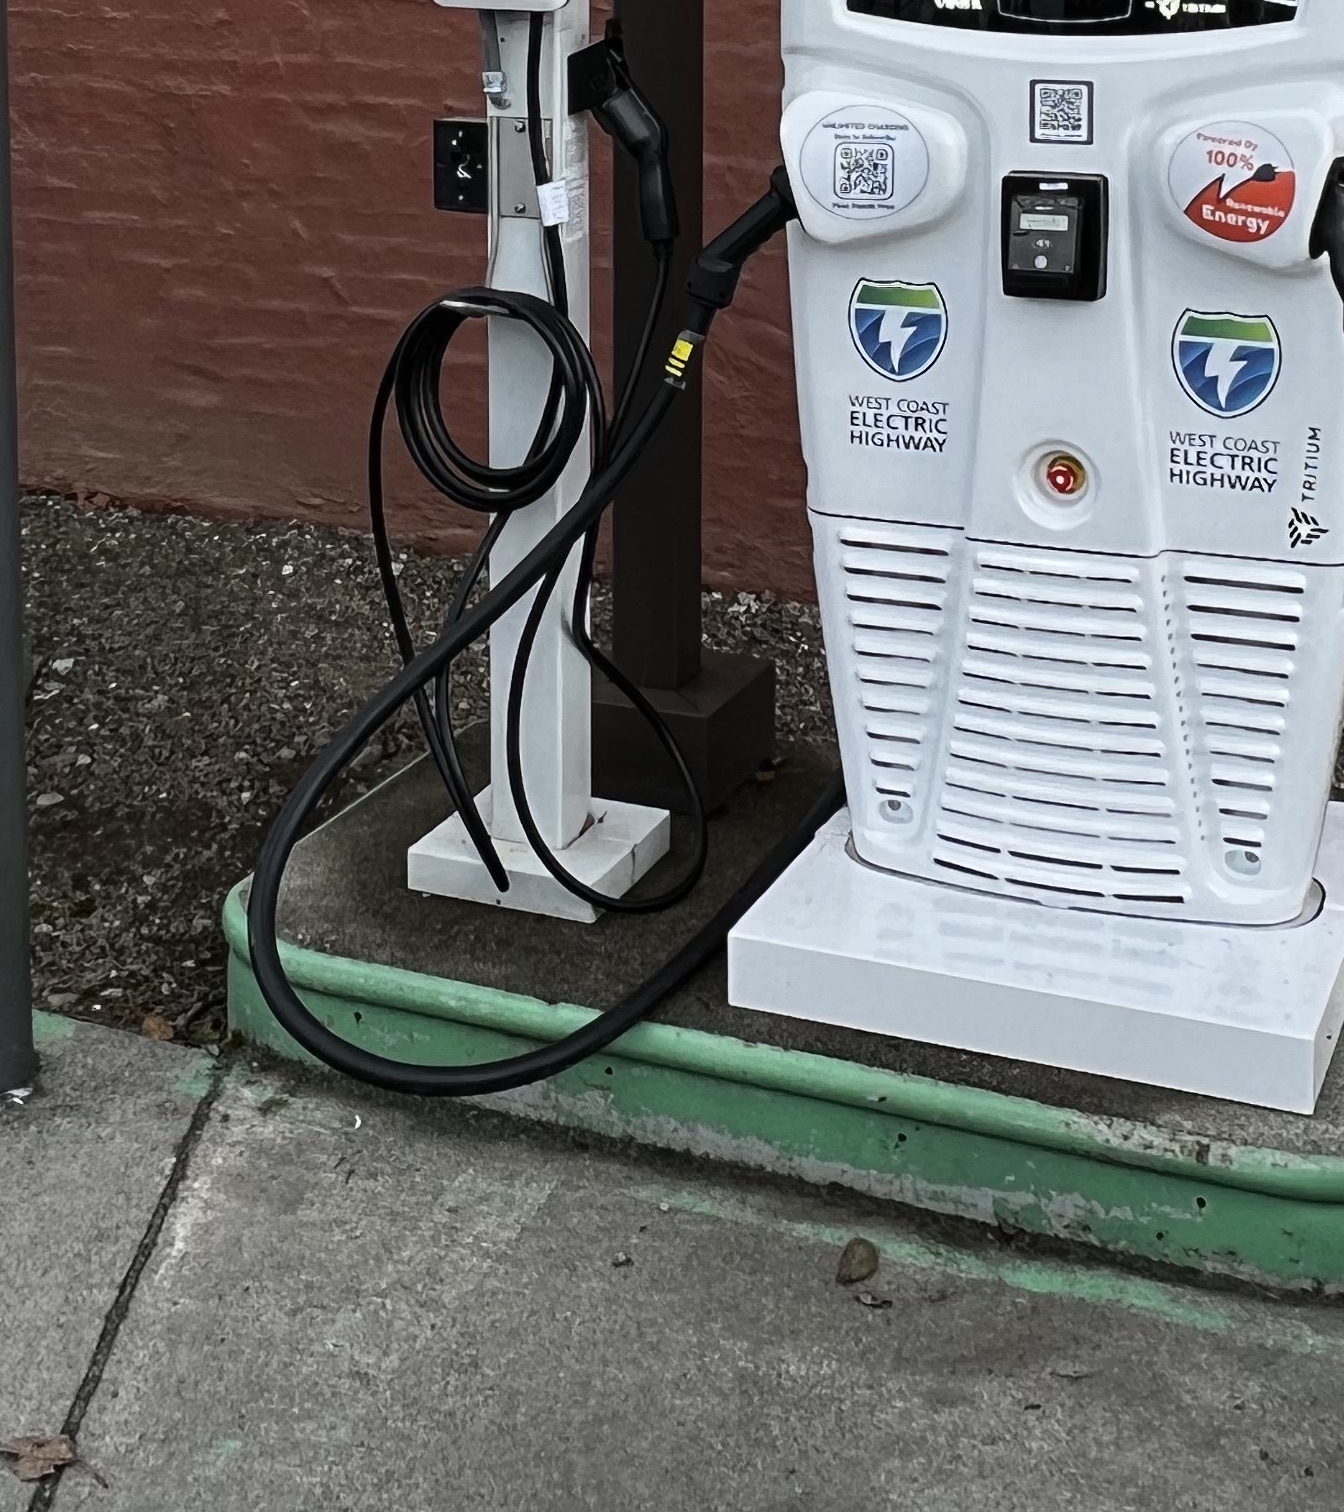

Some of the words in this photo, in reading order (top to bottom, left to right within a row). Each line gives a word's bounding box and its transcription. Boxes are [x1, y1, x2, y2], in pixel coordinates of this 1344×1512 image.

[1197, 132, 1242, 147] Powered
[1206, 149, 1255, 171] 100%
[1201, 204, 1270, 235] Energy
[849, 394, 892, 411] WEST
[896, 398, 950, 416] COAST
[850, 410, 948, 435] ELECTRIC
[850, 430, 947, 453] HIGHWAY
[1169, 431, 1217, 449] WEST
[1222, 436, 1281, 455] COAST
[1169, 447, 1279, 475] ELECTRIC
[1301, 426, 1322, 503] TRITIUM
[1169, 467, 1278, 493] HIGHWAY
